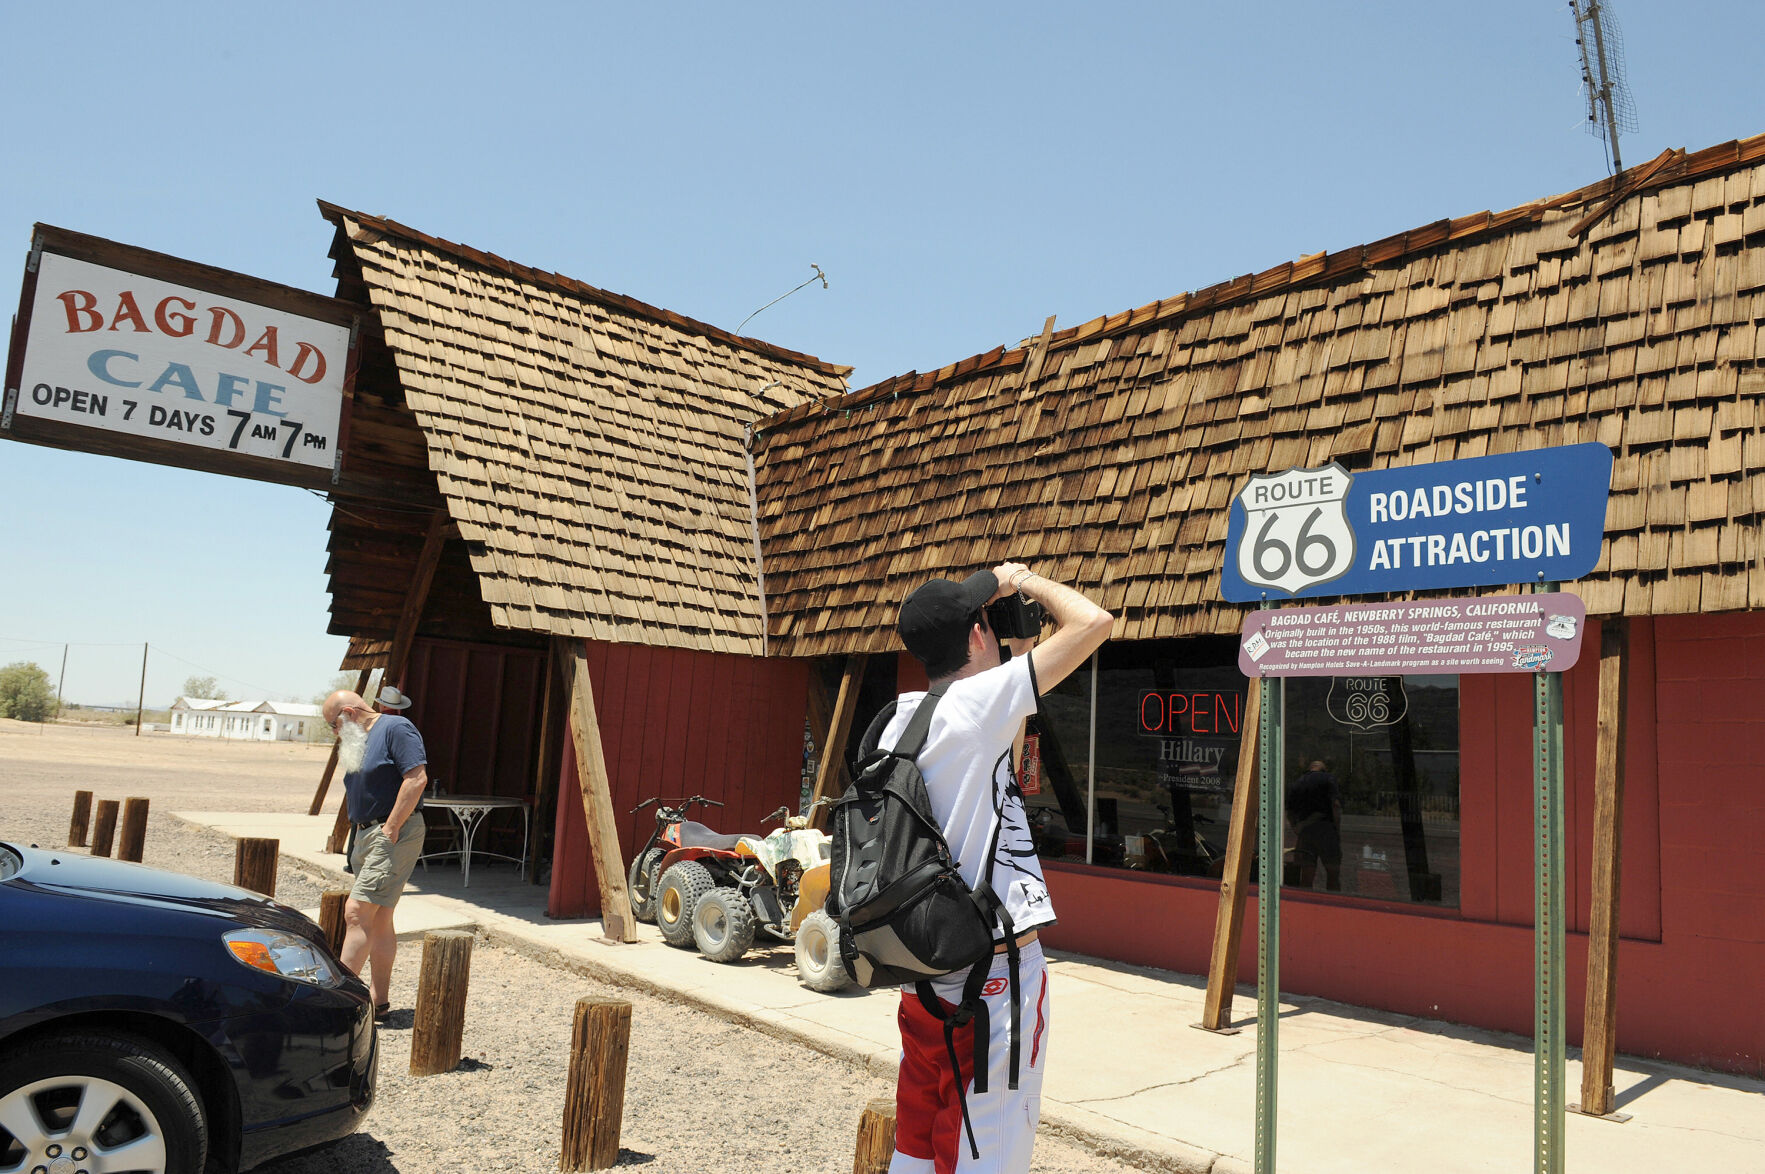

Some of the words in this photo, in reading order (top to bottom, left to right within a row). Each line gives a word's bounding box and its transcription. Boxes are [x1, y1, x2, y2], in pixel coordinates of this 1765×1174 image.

[56, 289, 327, 385] BAGDAD
[87, 349, 289, 418] CAFE
[32, 383, 107, 416] OPEN
[122, 400, 138, 421] 7
[149, 405, 215, 436] DAYS
[1255, 476, 1334, 504] ROUTE
[1370, 475, 1527, 524] ROADSIDE
[1253, 506, 1337, 581] 66
[1369, 522, 1571, 571] ATTRACTION
[1265, 628, 1304, 639] Originally
[1306, 626, 1326, 637] built
[1328, 627, 1337, 636] in
[1339, 626, 1354, 635] the
[1357, 624, 1388, 635] 1950s,
[1391, 623, 1409, 633] this
[1412, 619, 1482, 632] world-famous
[1486, 618, 1542, 629] restaurant
[1270, 614, 1311, 626] BAGDAD
[1314, 609, 1341, 625] CAFÉ,
[1344, 609, 1405, 622] NEWBERRY
[1408, 605, 1461, 619] SPRINGS,
[1270, 641, 1287, 649] was
[1289, 639, 1303, 648] the
[1305, 637, 1340, 647] location
[1342, 636, 1352, 646] of
[1354, 636, 1369, 645] the
[1372, 634, 1396, 644] 1988
[1398, 634, 1420, 645] film,
[1502, 630, 1535, 640] which
[1285, 649, 1318, 658] became
[1321, 648, 1335, 657] the
[1337, 648, 1357, 657] new
[1358, 647, 1385, 656] name
[1387, 646, 1398, 655] of
[1400, 645, 1416, 655] the
[1417, 643, 1470, 654] restaurant
[1473, 643, 1482, 652] in
[1487, 642, 1518, 652] 1995.
[1259, 663, 1290, 671] Recognized
[1291, 662, 1298, 670] by
[1299, 662, 1325, 670] Hampton
[1325, 661, 1345, 669] Hotels
[1402, 659, 1430, 668] program
[1447, 657, 1459, 666] site
[1460, 657, 1480, 665] worth
[1481, 657, 1504, 666] seeing
[1346, 678, 1388, 692] ROUTE
[1141, 693, 1239, 734] OPEN
[1346, 693, 1390, 722] 66
[1160, 740, 1225, 767] Hillary
[1200, 776, 1221, 786] 2008
